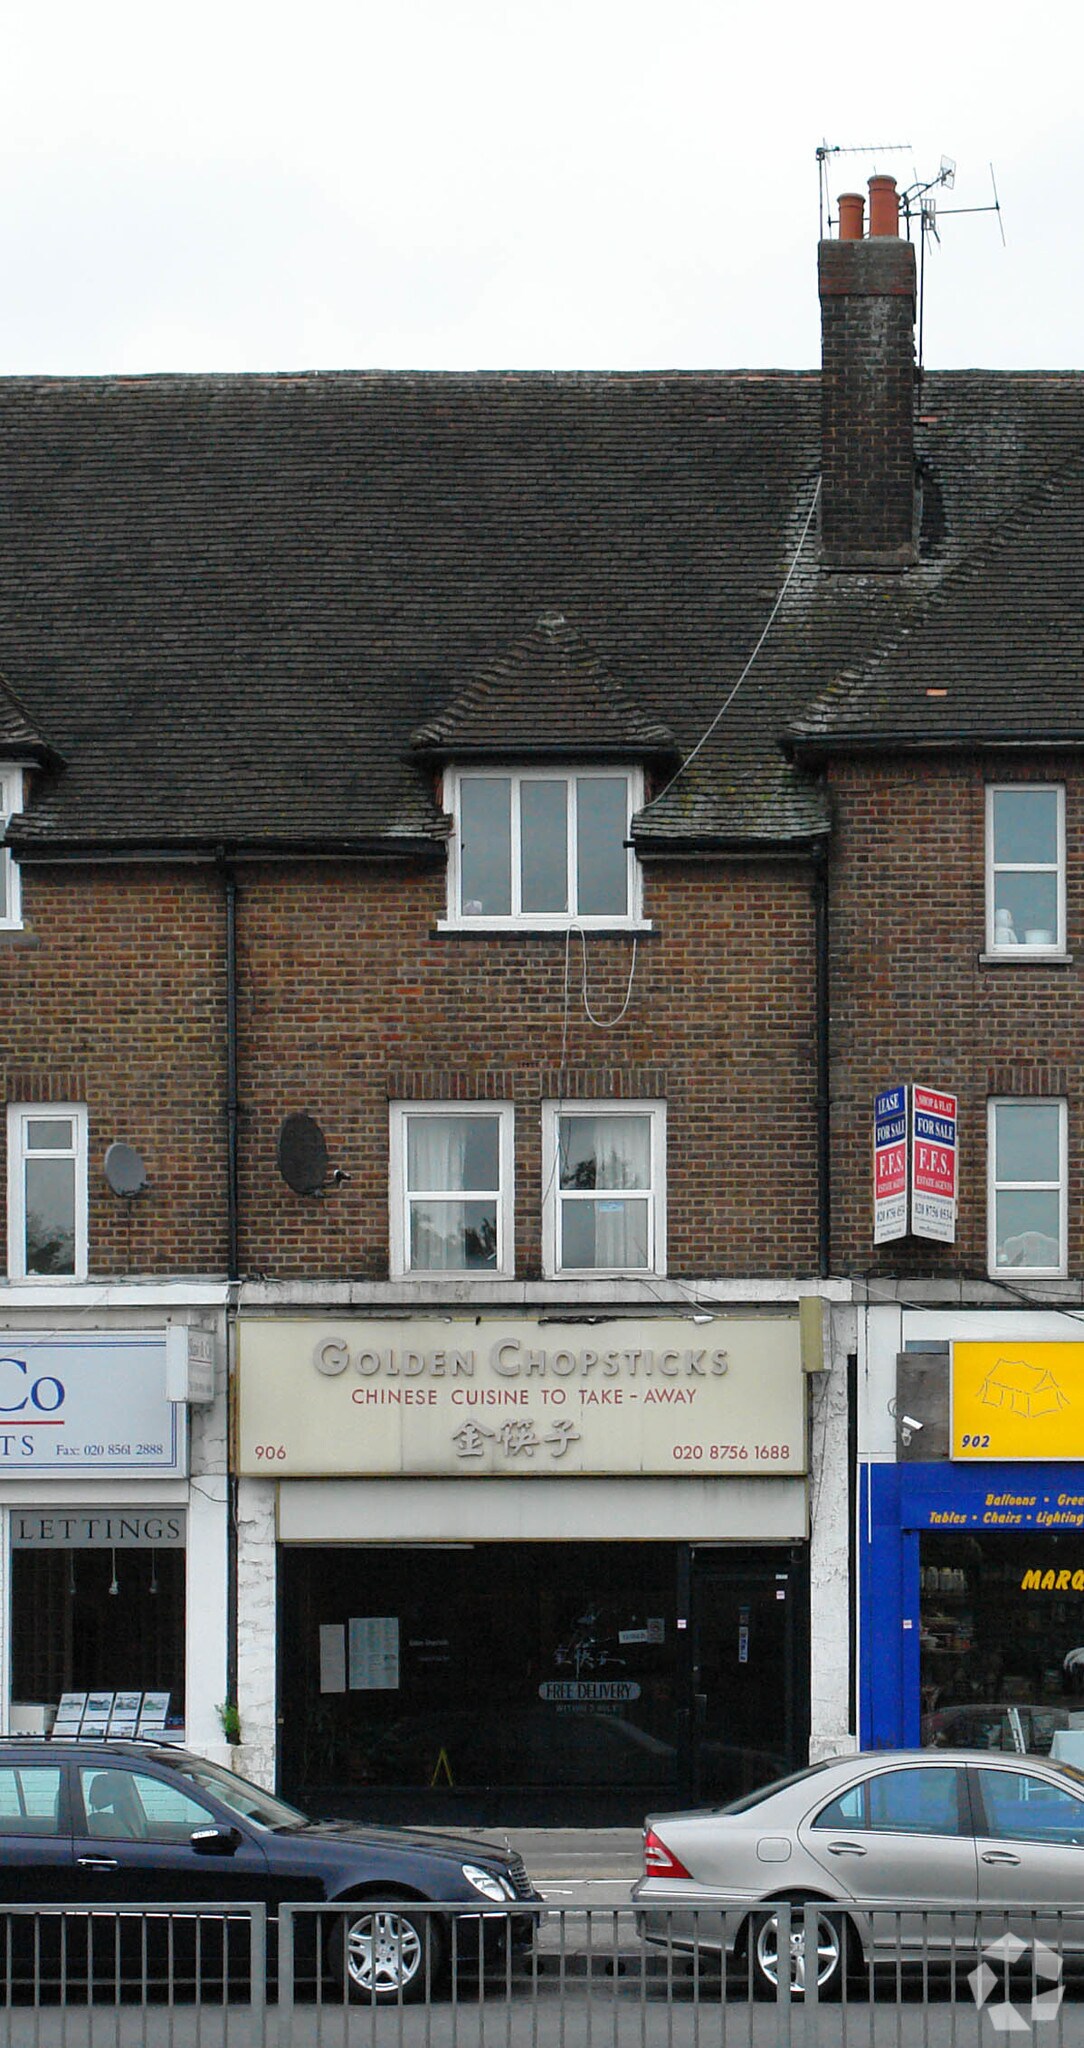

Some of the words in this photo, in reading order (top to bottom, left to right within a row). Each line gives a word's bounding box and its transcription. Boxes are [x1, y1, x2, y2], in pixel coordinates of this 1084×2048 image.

[878, 1093, 899, 1115] LEASE
[877, 1125, 891, 1142] FOR
[917, 1117, 935, 1135] FOR
[935, 1122, 954, 1140] SALE
[879, 1150, 904, 1178] F.F.S.
[919, 1147, 950, 1176] F.F.S.
[312, 1336, 475, 1378] GOLDEN
[489, 1337, 729, 1378] CHOPSTICKS
[351, 1389, 438, 1405] CHINESE
[451, 1389, 529, 1405] CUISINE
[541, 1389, 566, 1405] TO
[961, 1435, 991, 1448] 902
[56, 1444, 79, 1456] Fax:
[83, 1445, 104, 1456] 020
[107, 1444, 131, 1456] 8561
[136, 1444, 163, 1456] 2888
[255, 1445, 287, 1460] 906
[672, 1445, 703, 1460] 020
[709, 1445, 748, 1460] 8756
[754, 1445, 790, 1460] 1688
[985, 1493, 1036, 1506] Balloons
[929, 1511, 967, 1524] Tables
[982, 1511, 1022, 1524] Chairs
[1036, 1511, 1084, 1526] Lighting
[19, 1519, 180, 1540] LETTINGS
[1021, 1569, 1084, 1591] MARQ
[546, 1684, 573, 1698] FREE
[577, 1684, 631, 1698] DELIVERY
